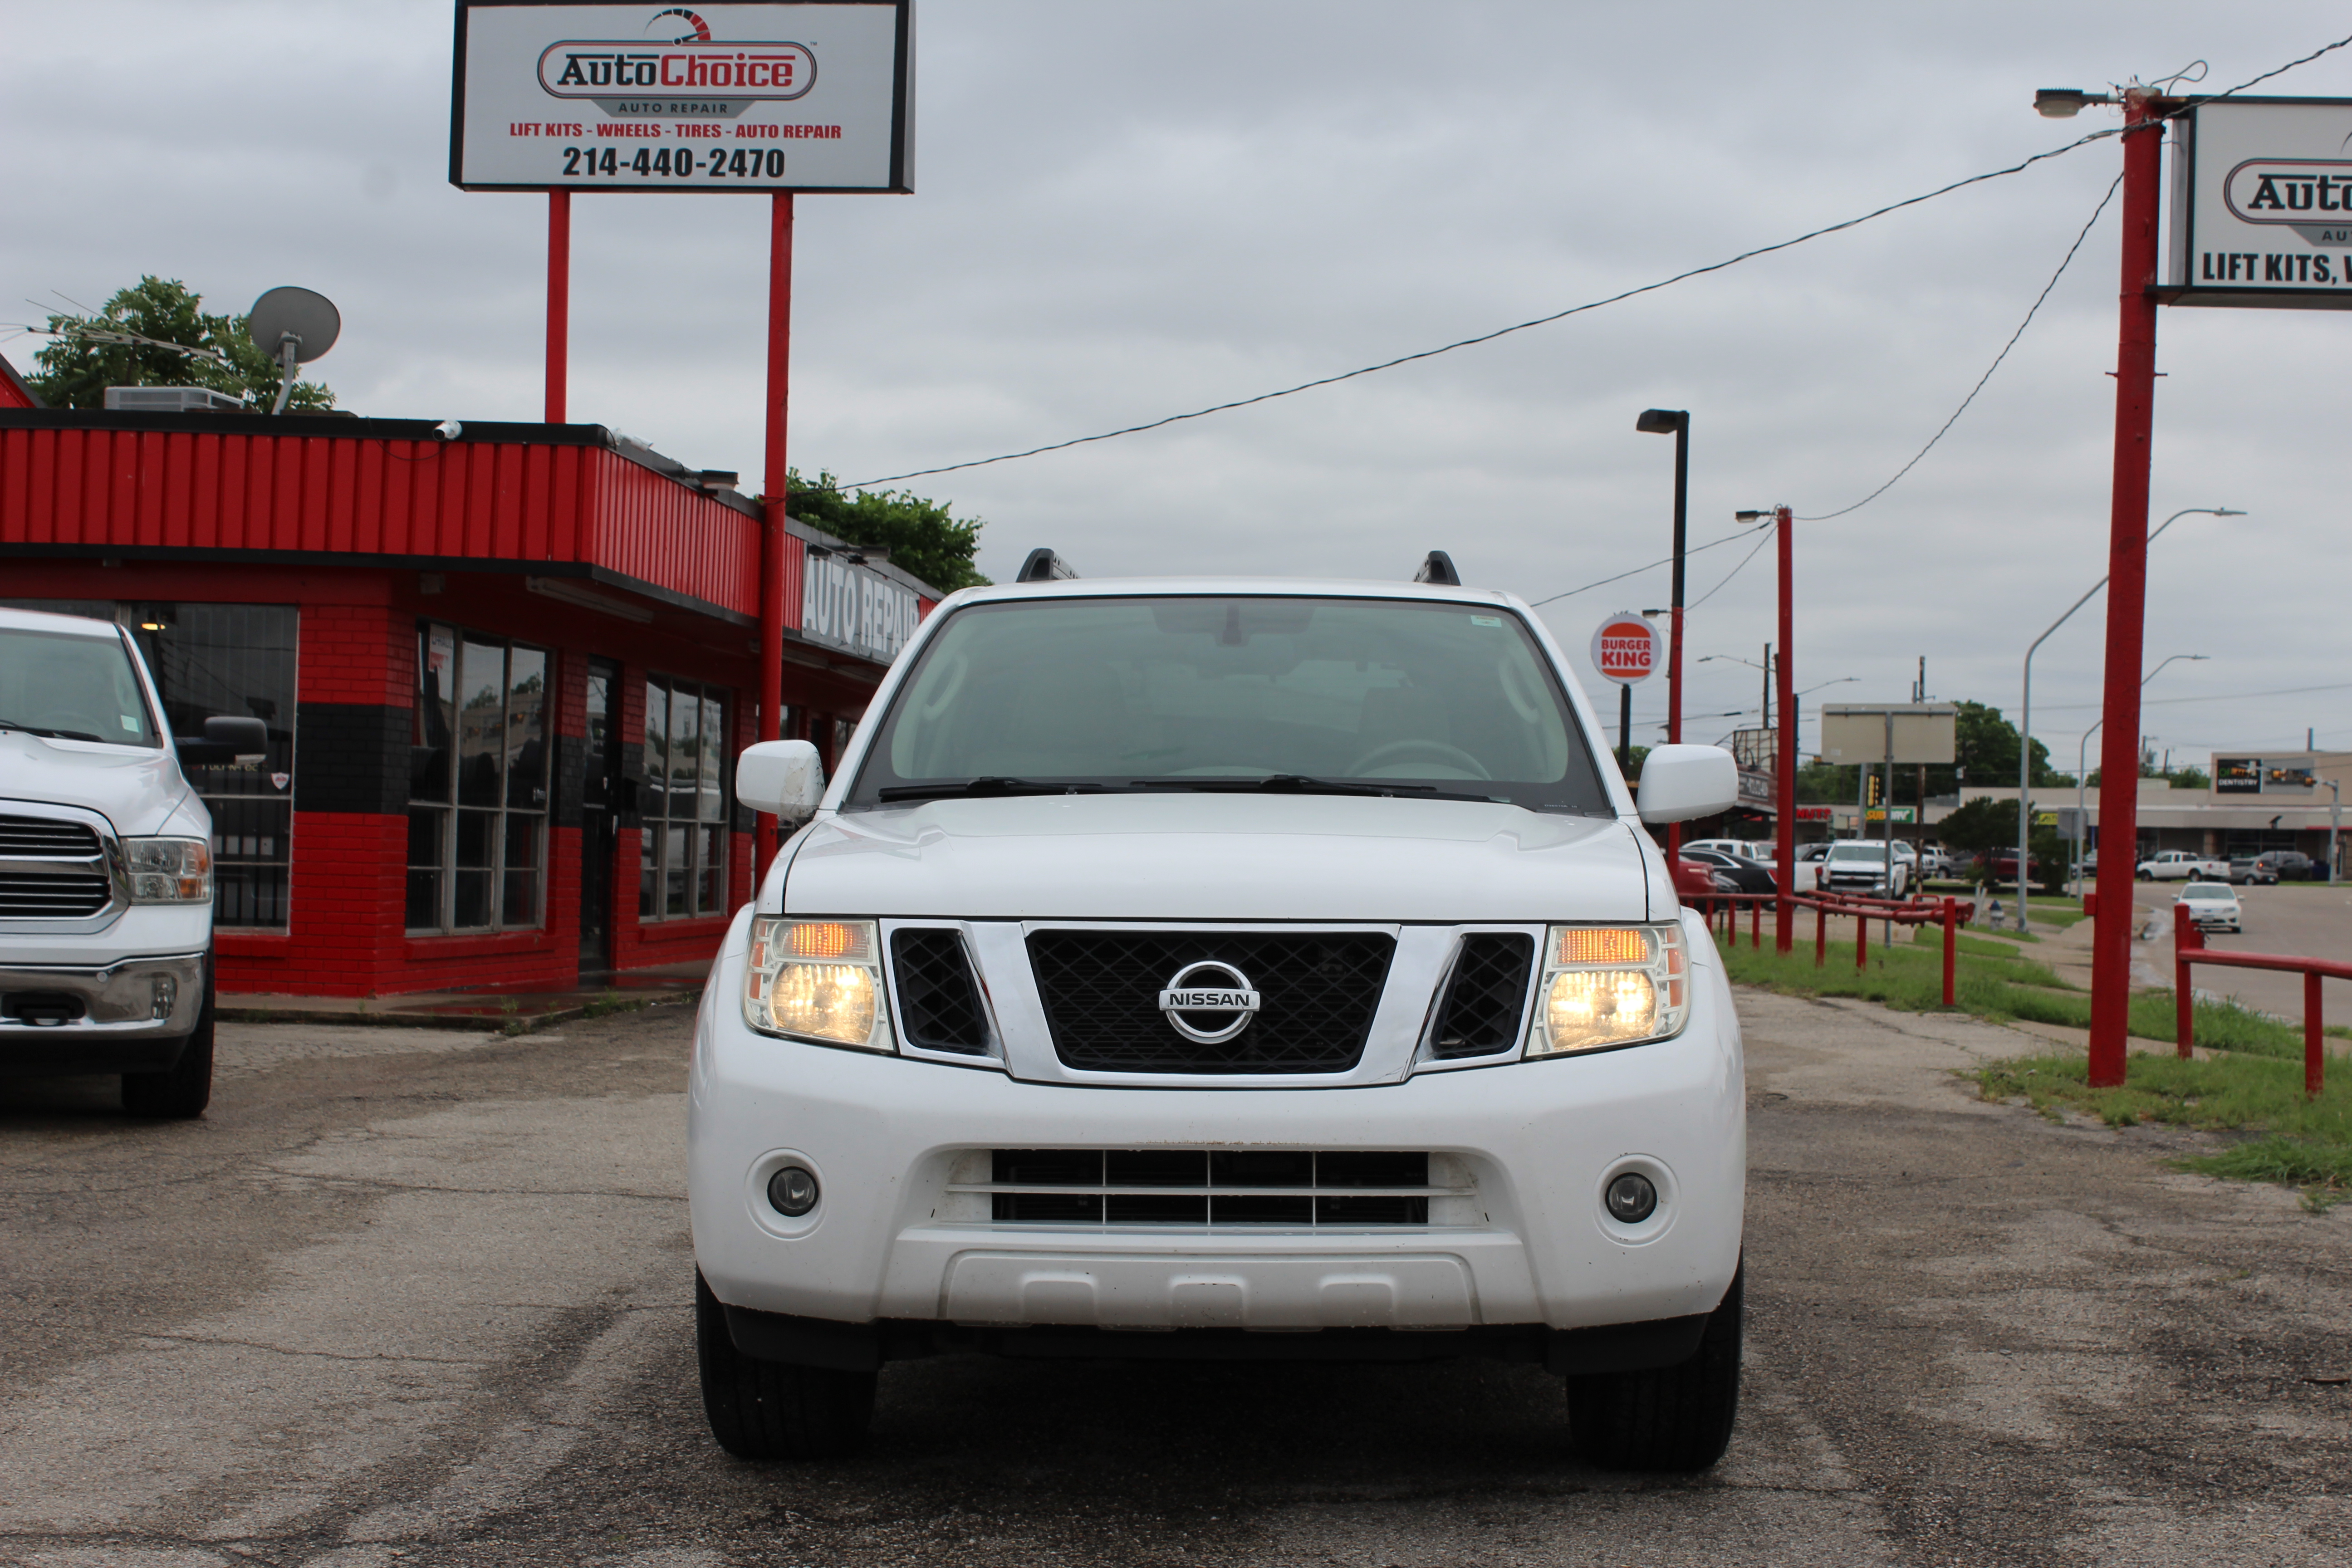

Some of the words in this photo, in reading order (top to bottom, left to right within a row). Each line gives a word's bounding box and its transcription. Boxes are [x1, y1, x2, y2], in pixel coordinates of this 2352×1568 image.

[557, 53, 795, 86] AutoChoice
[618, 103, 662, 113] AUTO
[670, 103, 728, 113] REPAIR
[510, 122, 542, 137] LIFT
[545, 123, 583, 137] KITS
[597, 123, 661, 137] WHEELS
[675, 124, 721, 138] TIRES
[735, 124, 779, 138] AUTO
[783, 125, 841, 139] REPAIR
[563, 147, 785, 178] 214-440-2470
[2322, 230, 2352, 241] AU
[2203, 252, 2259, 280] LIFT
[2265, 253, 2337, 285] KITS,
[802, 553, 857, 644] AUTO
[861, 576, 920, 656] REPAIR
[1602, 639, 1651, 650] BURGER
[1602, 651, 1651, 666] KING
[1796, 808, 1831, 820] NUTS
[1170, 993, 1250, 1006] NISSAN
